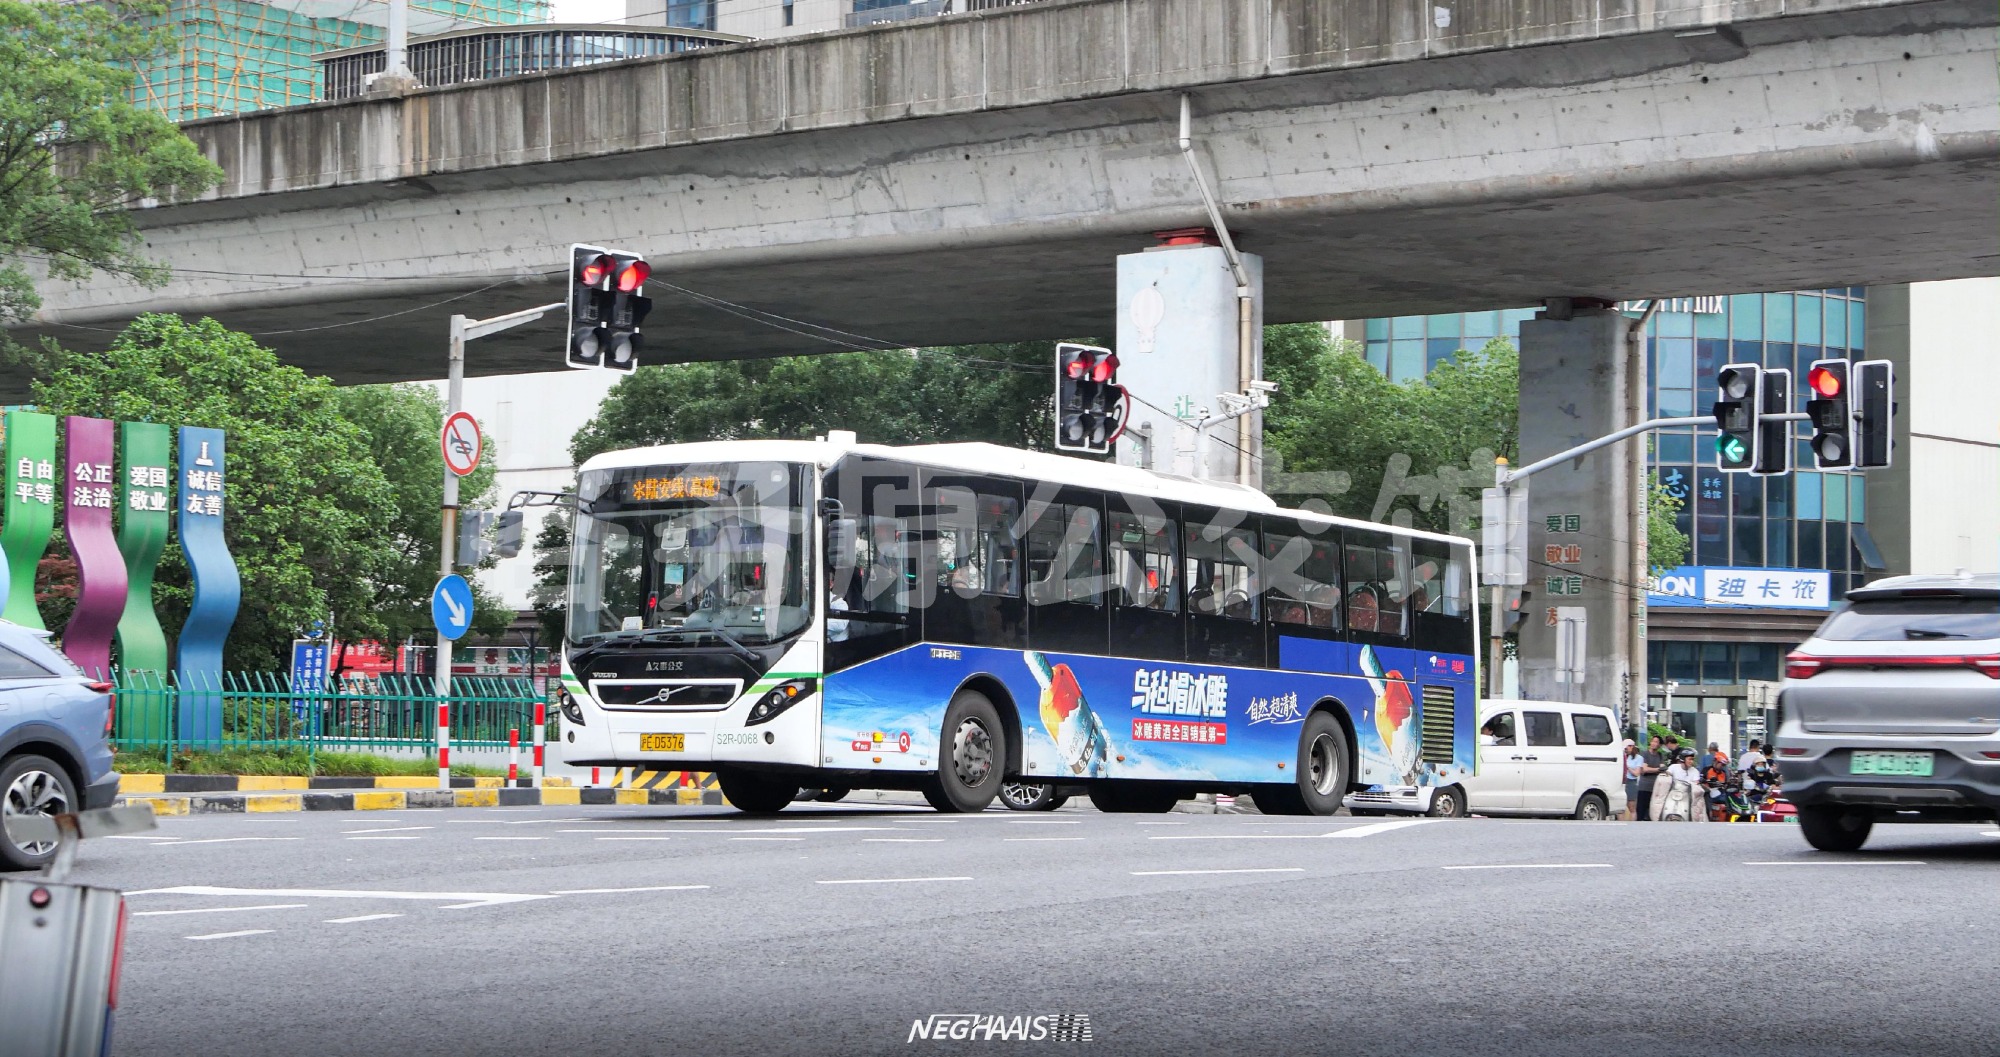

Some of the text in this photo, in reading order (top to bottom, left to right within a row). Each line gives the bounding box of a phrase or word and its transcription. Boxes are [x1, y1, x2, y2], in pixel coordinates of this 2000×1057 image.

[1174, 394, 1194, 419] 让
[18, 457, 53, 480] 自由
[74, 462, 112, 483] 公正
[130, 466, 167, 488] 爱国
[187, 469, 222, 492] 诚信
[15, 482, 54, 504] 平等
[73, 487, 112, 508] 法治
[130, 490, 167, 511] 敬业
[187, 494, 222, 516] 友善
[1546, 515, 1581, 533] 爱国
[1546, 545, 1581, 563] 敬业
[1546, 576, 1582, 595] 诚信
[1717, 577, 1817, 599] 迪卡侬
[1131, 668, 1228, 717] 乌毡帽冰雕
[716, 733, 758, 745] S2R-0068
[1134, 722, 1226, 742] 冰雕黄酒全国销量第一
